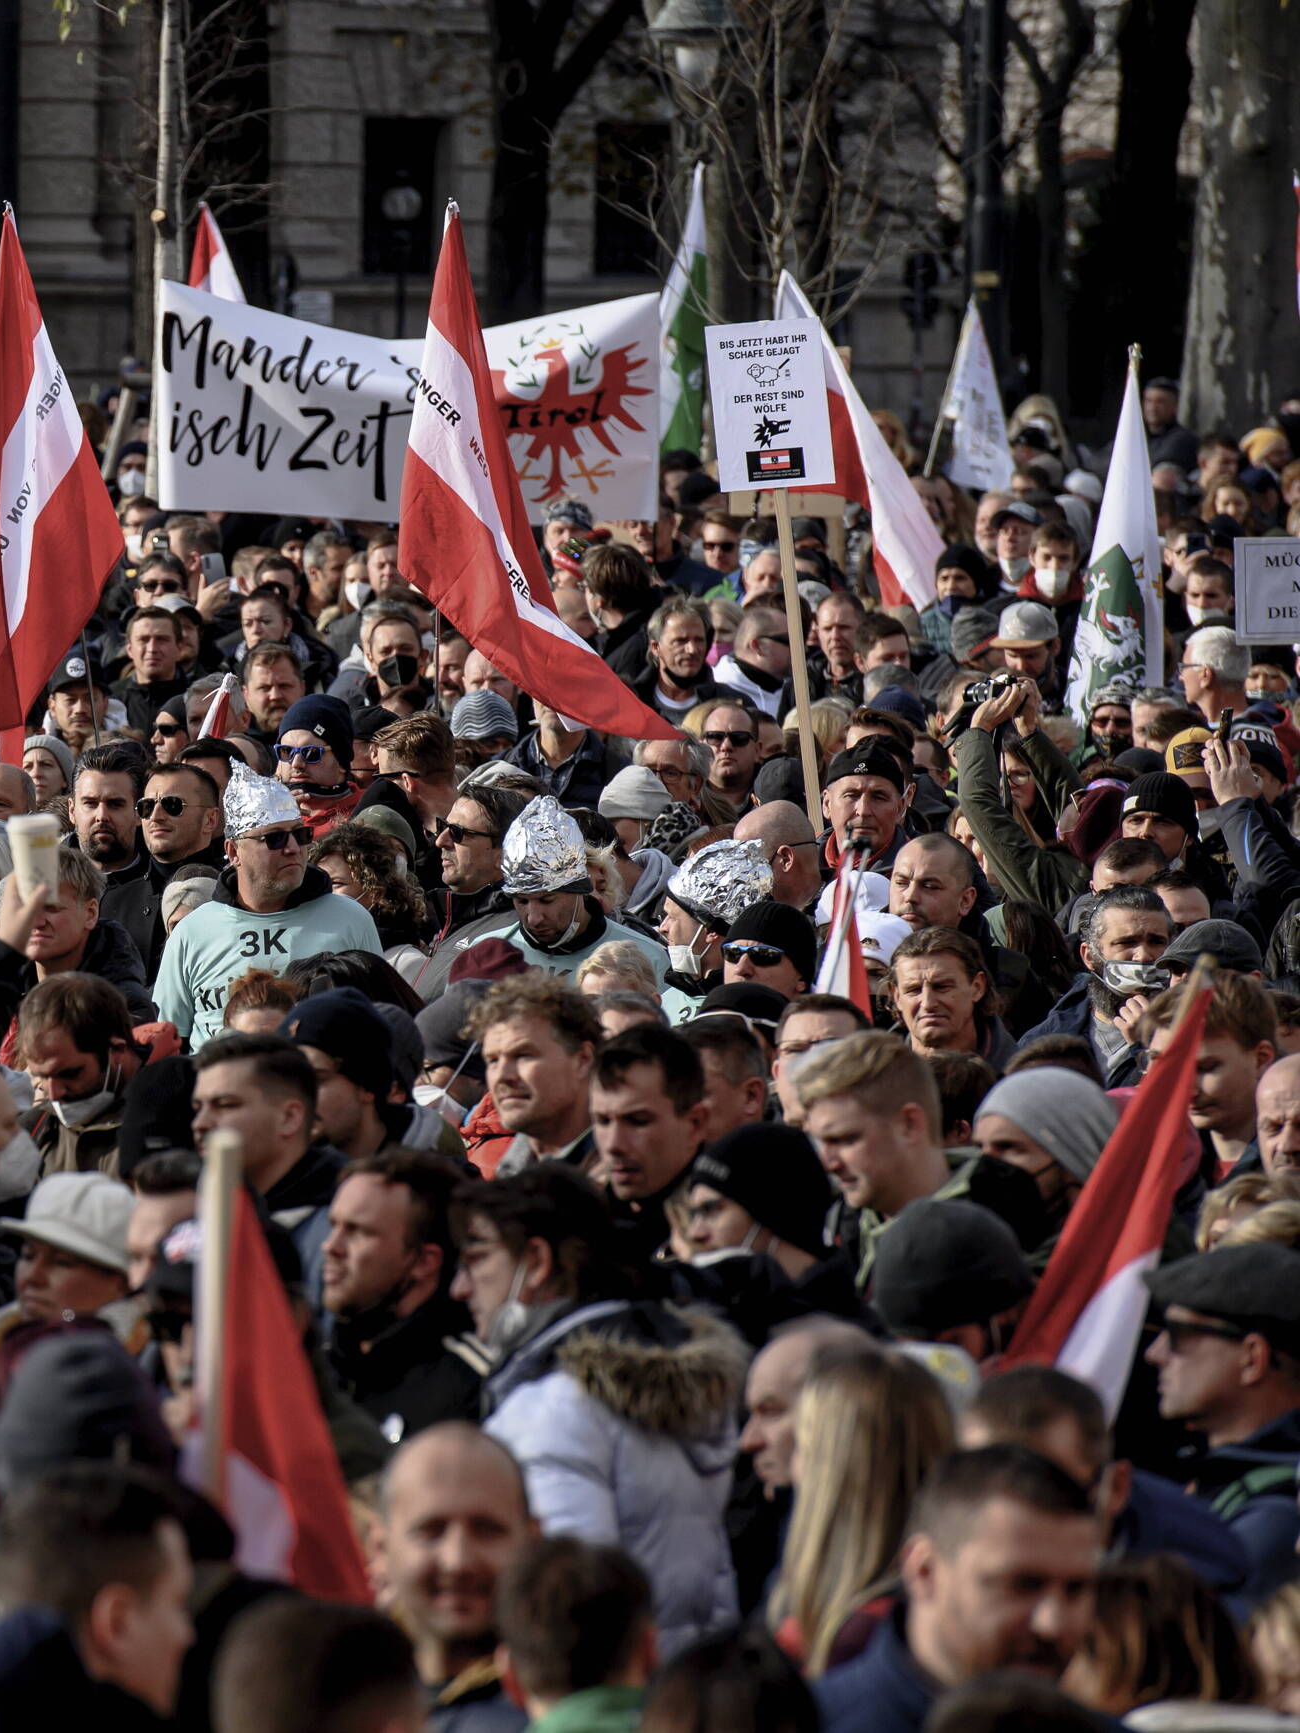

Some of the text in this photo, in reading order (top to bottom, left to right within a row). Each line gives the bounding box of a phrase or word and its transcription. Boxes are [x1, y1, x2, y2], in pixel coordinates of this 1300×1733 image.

[720, 334, 807, 350] BIS JETZT HABT IHR
[162, 311, 376, 394] Mander
[728, 346, 800, 360] SCHAFE GEJAGT
[734, 390, 805, 404] DER REST SIND
[500, 389, 607, 429] Tirol
[753, 403, 787, 414] WÖLFE
[170, 385, 414, 502] isch Zeit
[1268, 606, 1299, 619] DIE
[240, 928, 288, 957] 3K
